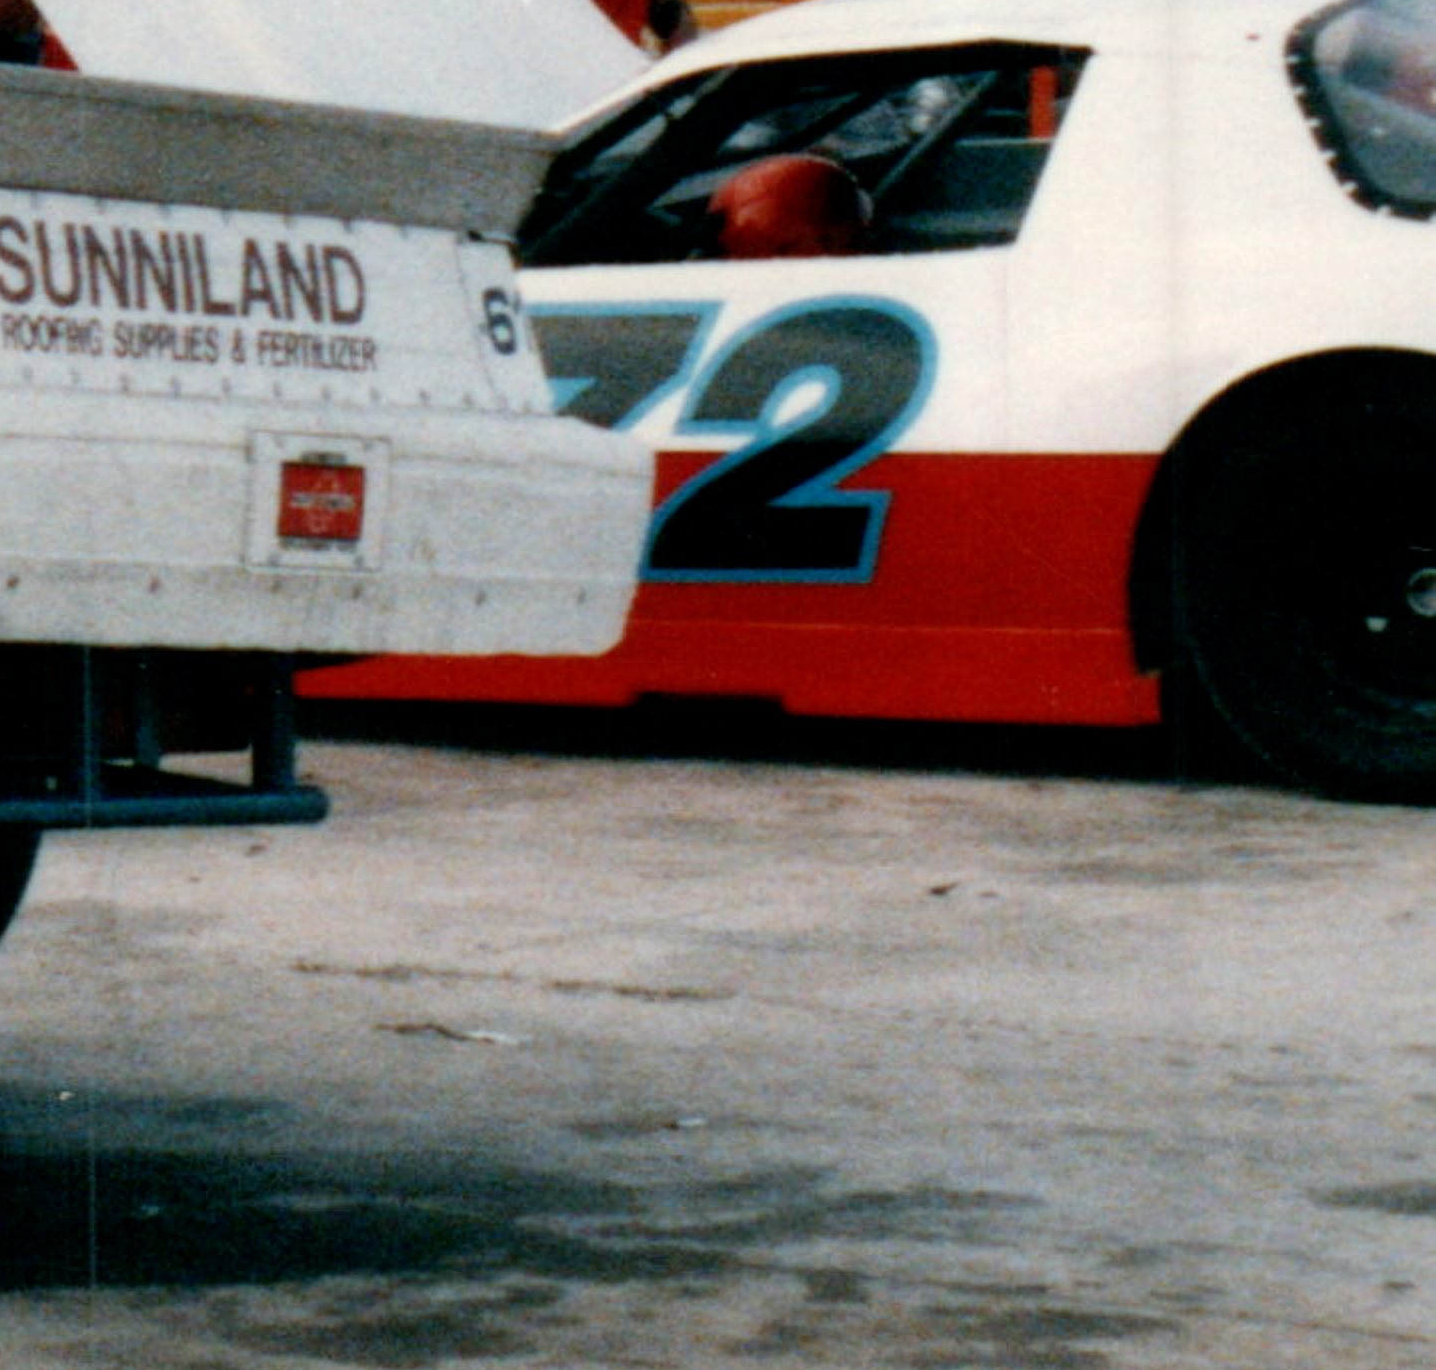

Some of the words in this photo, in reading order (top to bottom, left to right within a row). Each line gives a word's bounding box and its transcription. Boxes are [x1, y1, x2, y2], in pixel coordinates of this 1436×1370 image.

[1, 312, 104, 357] ROOFING
[112, 320, 220, 364] SUPPLIES
[256, 328, 379, 373] FERTILIZER
[526, 293, 939, 583] 72
